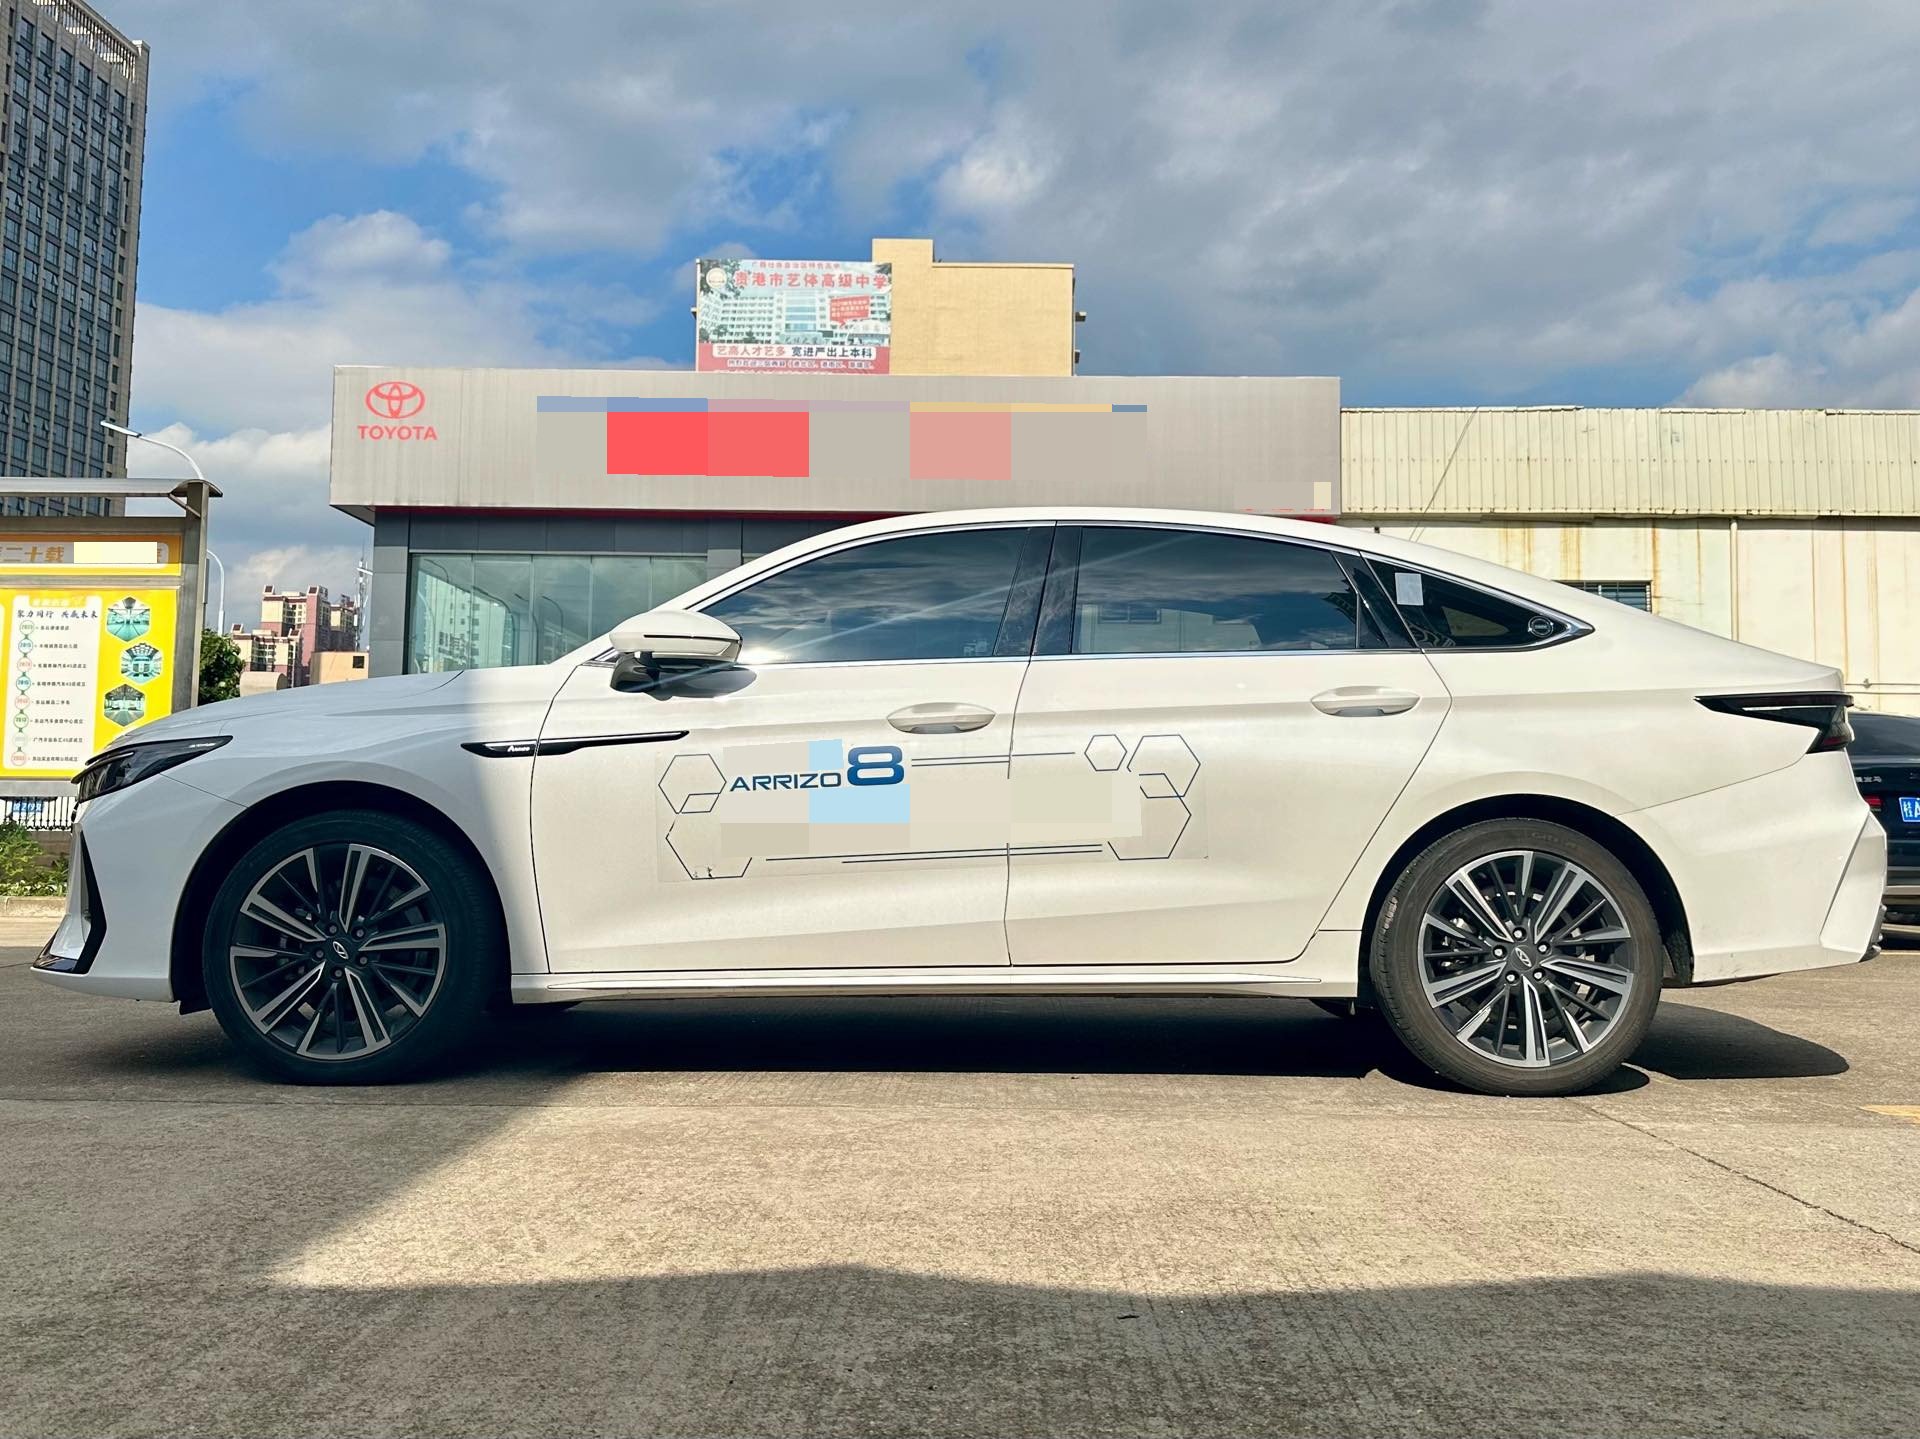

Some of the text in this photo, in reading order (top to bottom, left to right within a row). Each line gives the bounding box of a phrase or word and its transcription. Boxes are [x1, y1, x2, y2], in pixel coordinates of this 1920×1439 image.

[734, 271, 888, 289] 贵港市艺体高级中学
[357, 425, 437, 441] TOYOTA
[729, 745, 905, 792] ARRIZO 8
